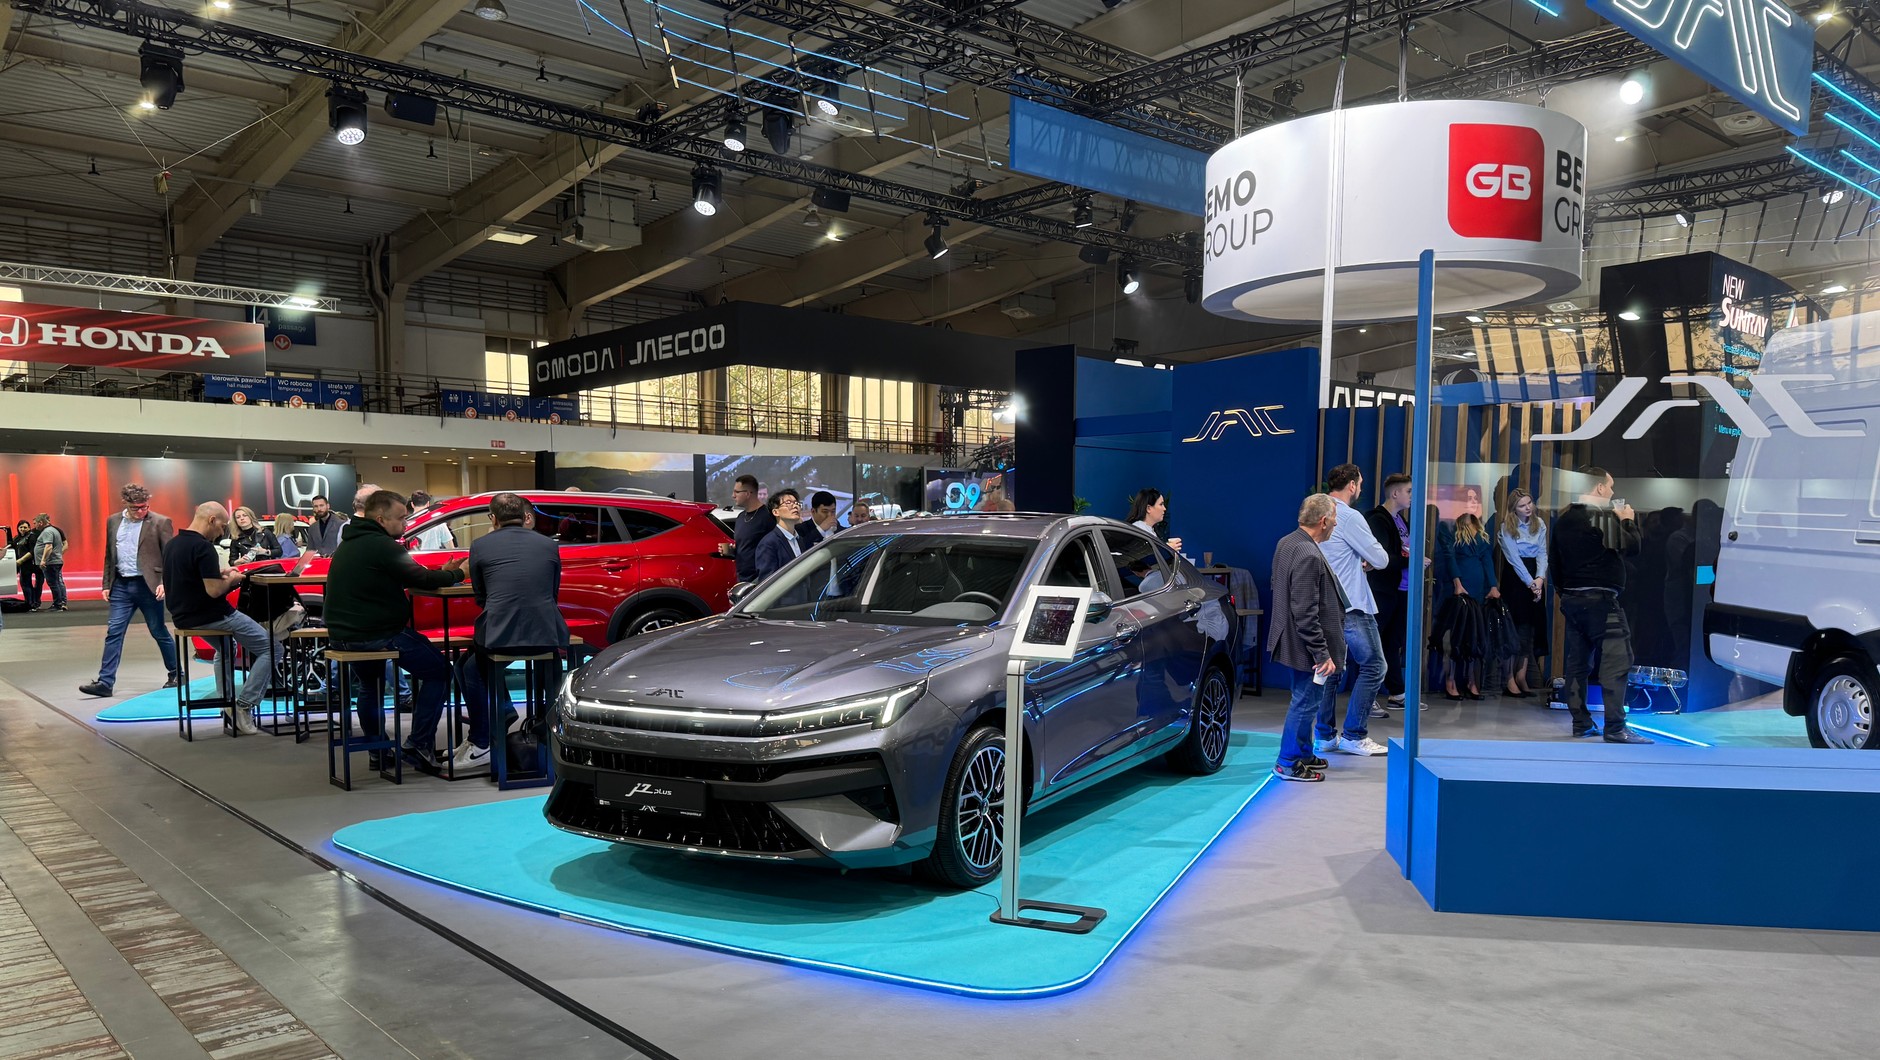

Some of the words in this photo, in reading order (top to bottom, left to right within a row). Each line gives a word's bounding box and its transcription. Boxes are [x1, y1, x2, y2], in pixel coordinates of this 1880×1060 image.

[1465, 163, 1532, 201] GB
[1556, 149, 1583, 197] BE
[1206, 170, 1257, 225] EMO
[1554, 196, 1582, 240] GR
[1205, 208, 1274, 266] ROUP
[1722, 273, 1745, 300] NEW
[37, 322, 231, 359] HONDA
[536, 347, 615, 383] OMODA
[628, 323, 726, 366] JAECOO
[289, 380, 313, 388] robocze
